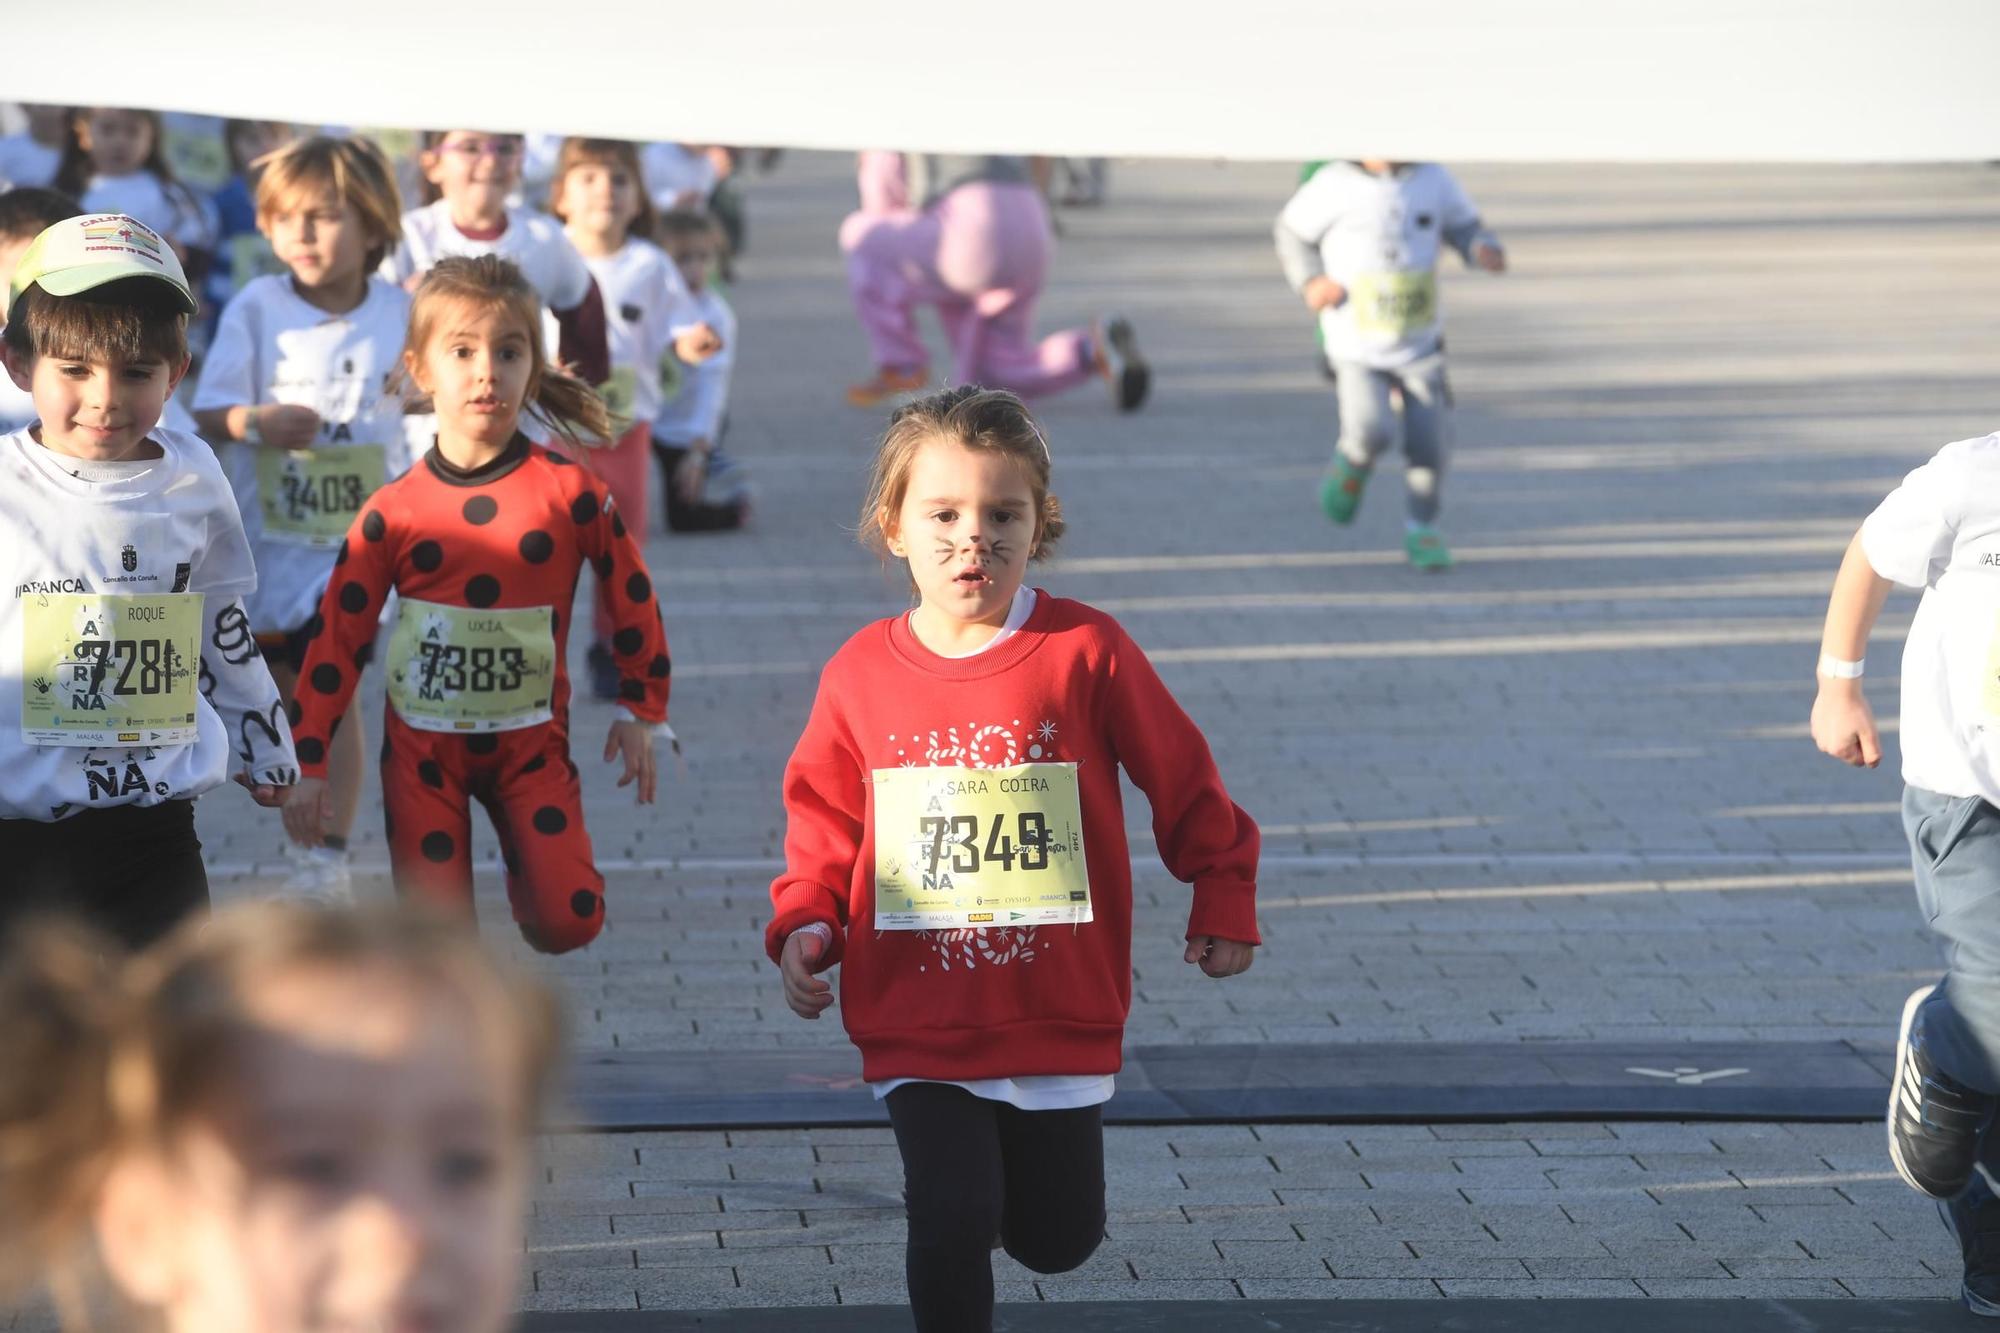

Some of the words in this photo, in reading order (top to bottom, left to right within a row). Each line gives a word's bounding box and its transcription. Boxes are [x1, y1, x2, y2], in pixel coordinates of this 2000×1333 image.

[128, 607, 165, 622] ROQUE
[82, 639, 171, 695] 7281
[420, 642, 522, 692] 7383
[947, 780, 988, 795] SARA
[1000, 778, 1050, 793] COIRA
[920, 812, 1048, 874] 7349
